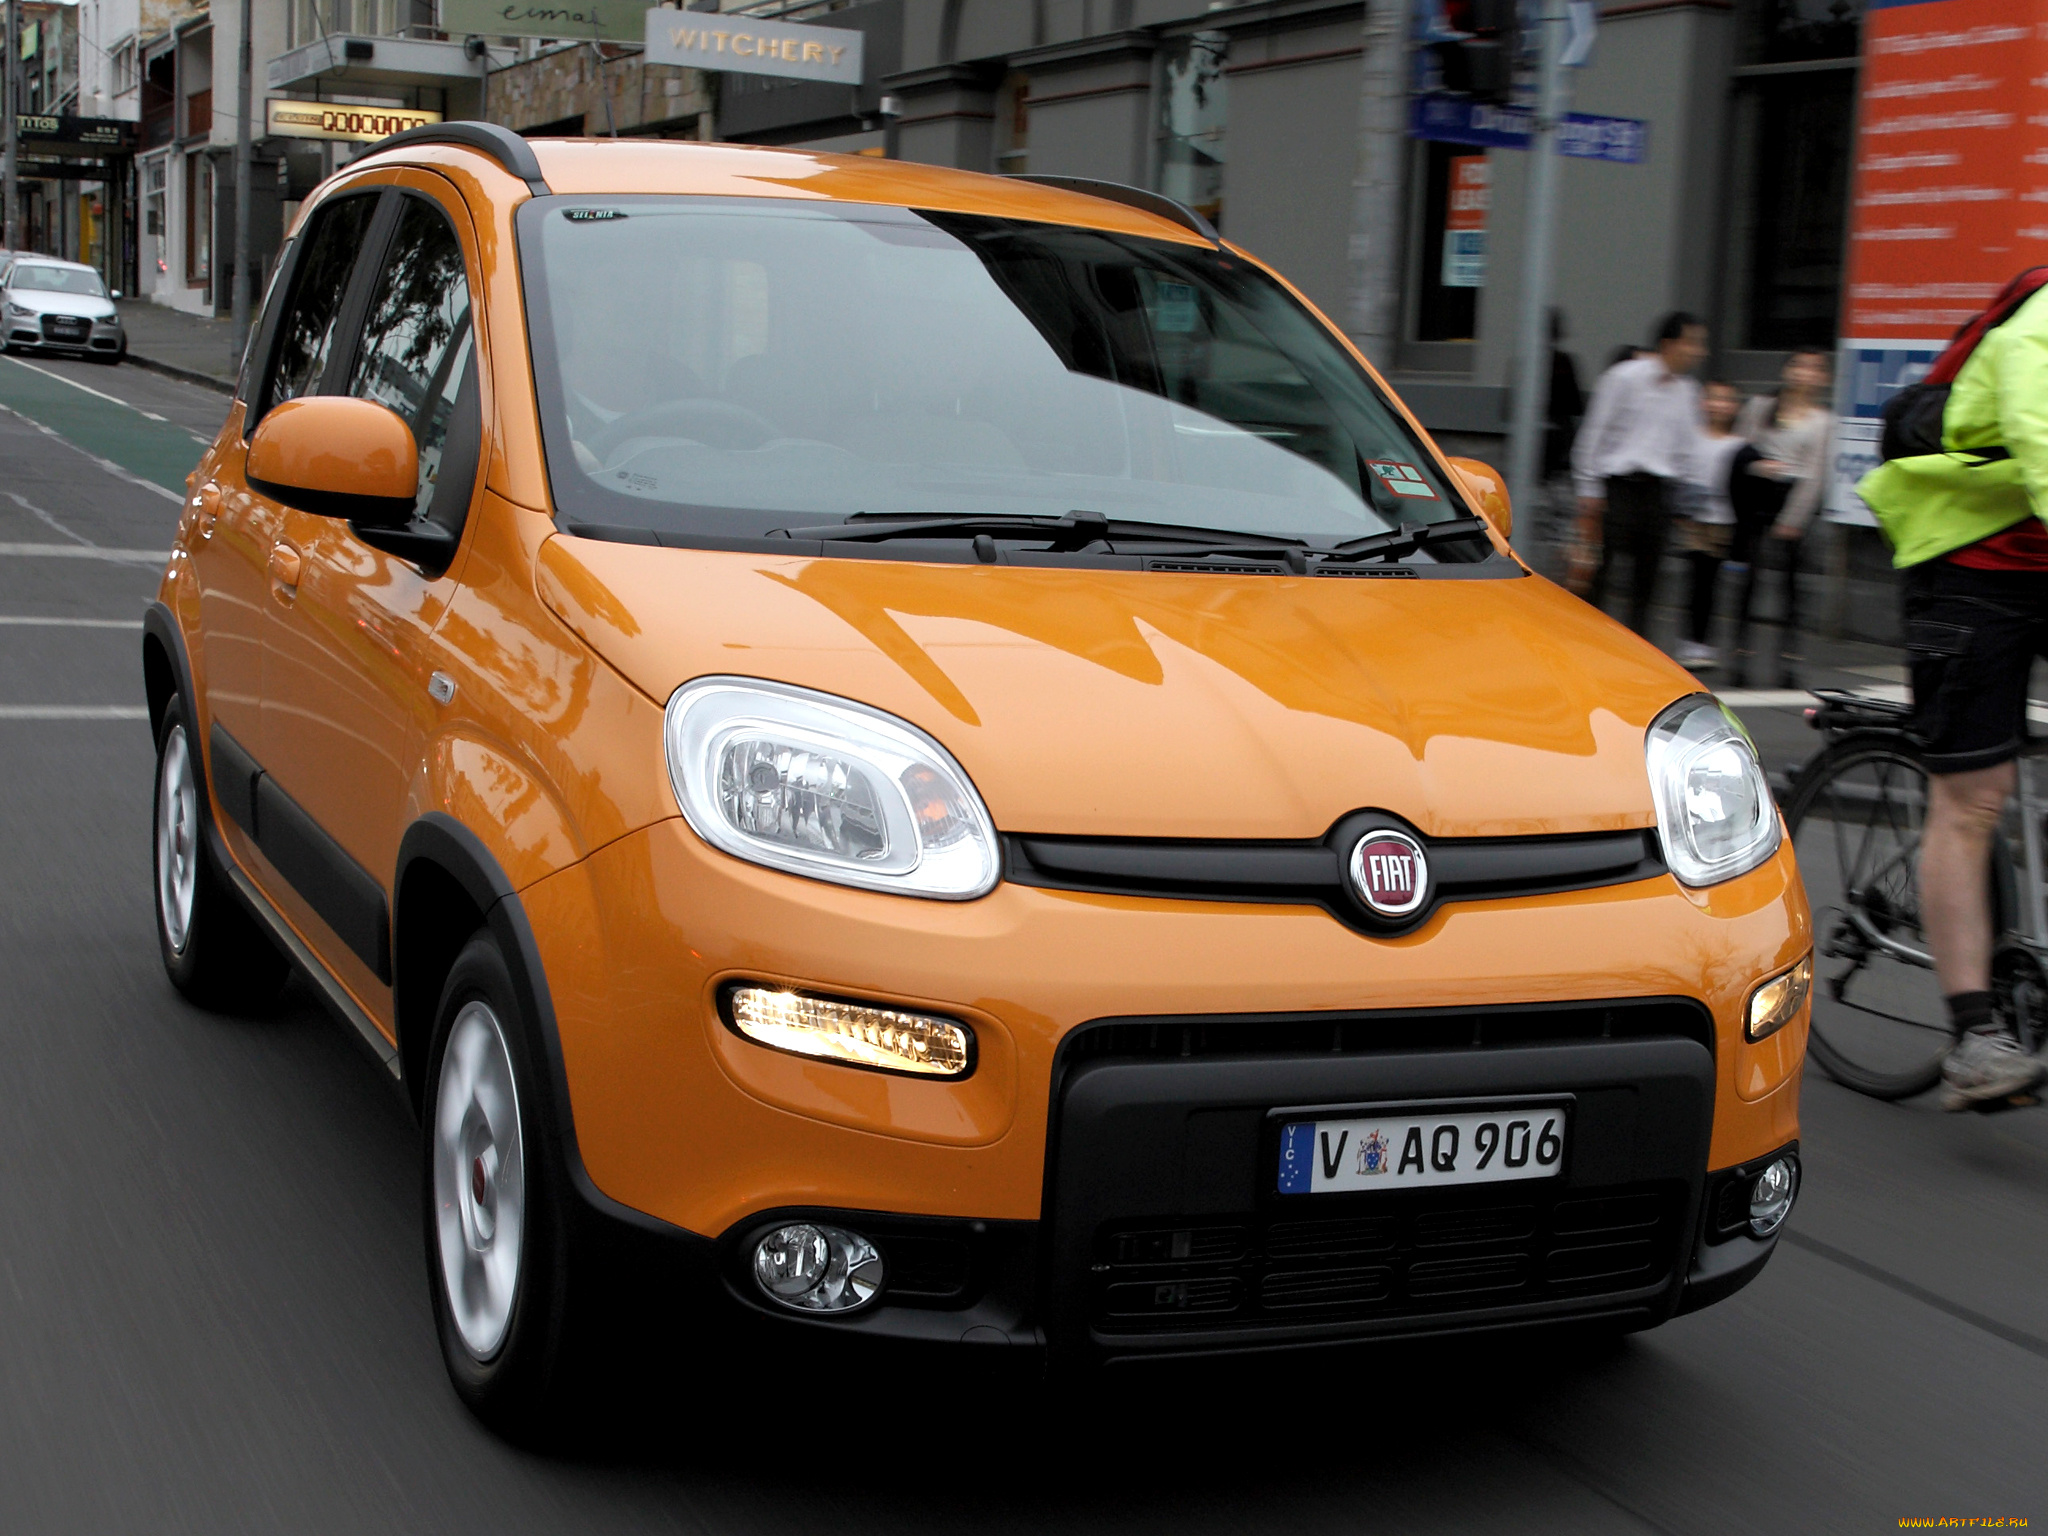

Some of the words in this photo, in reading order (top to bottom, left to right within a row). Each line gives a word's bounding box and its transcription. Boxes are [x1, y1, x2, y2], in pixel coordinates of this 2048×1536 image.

[670, 28, 847, 65] WITCHERY
[1369, 855, 1411, 892] FIAT
[1285, 1125, 1297, 1161] VIC
